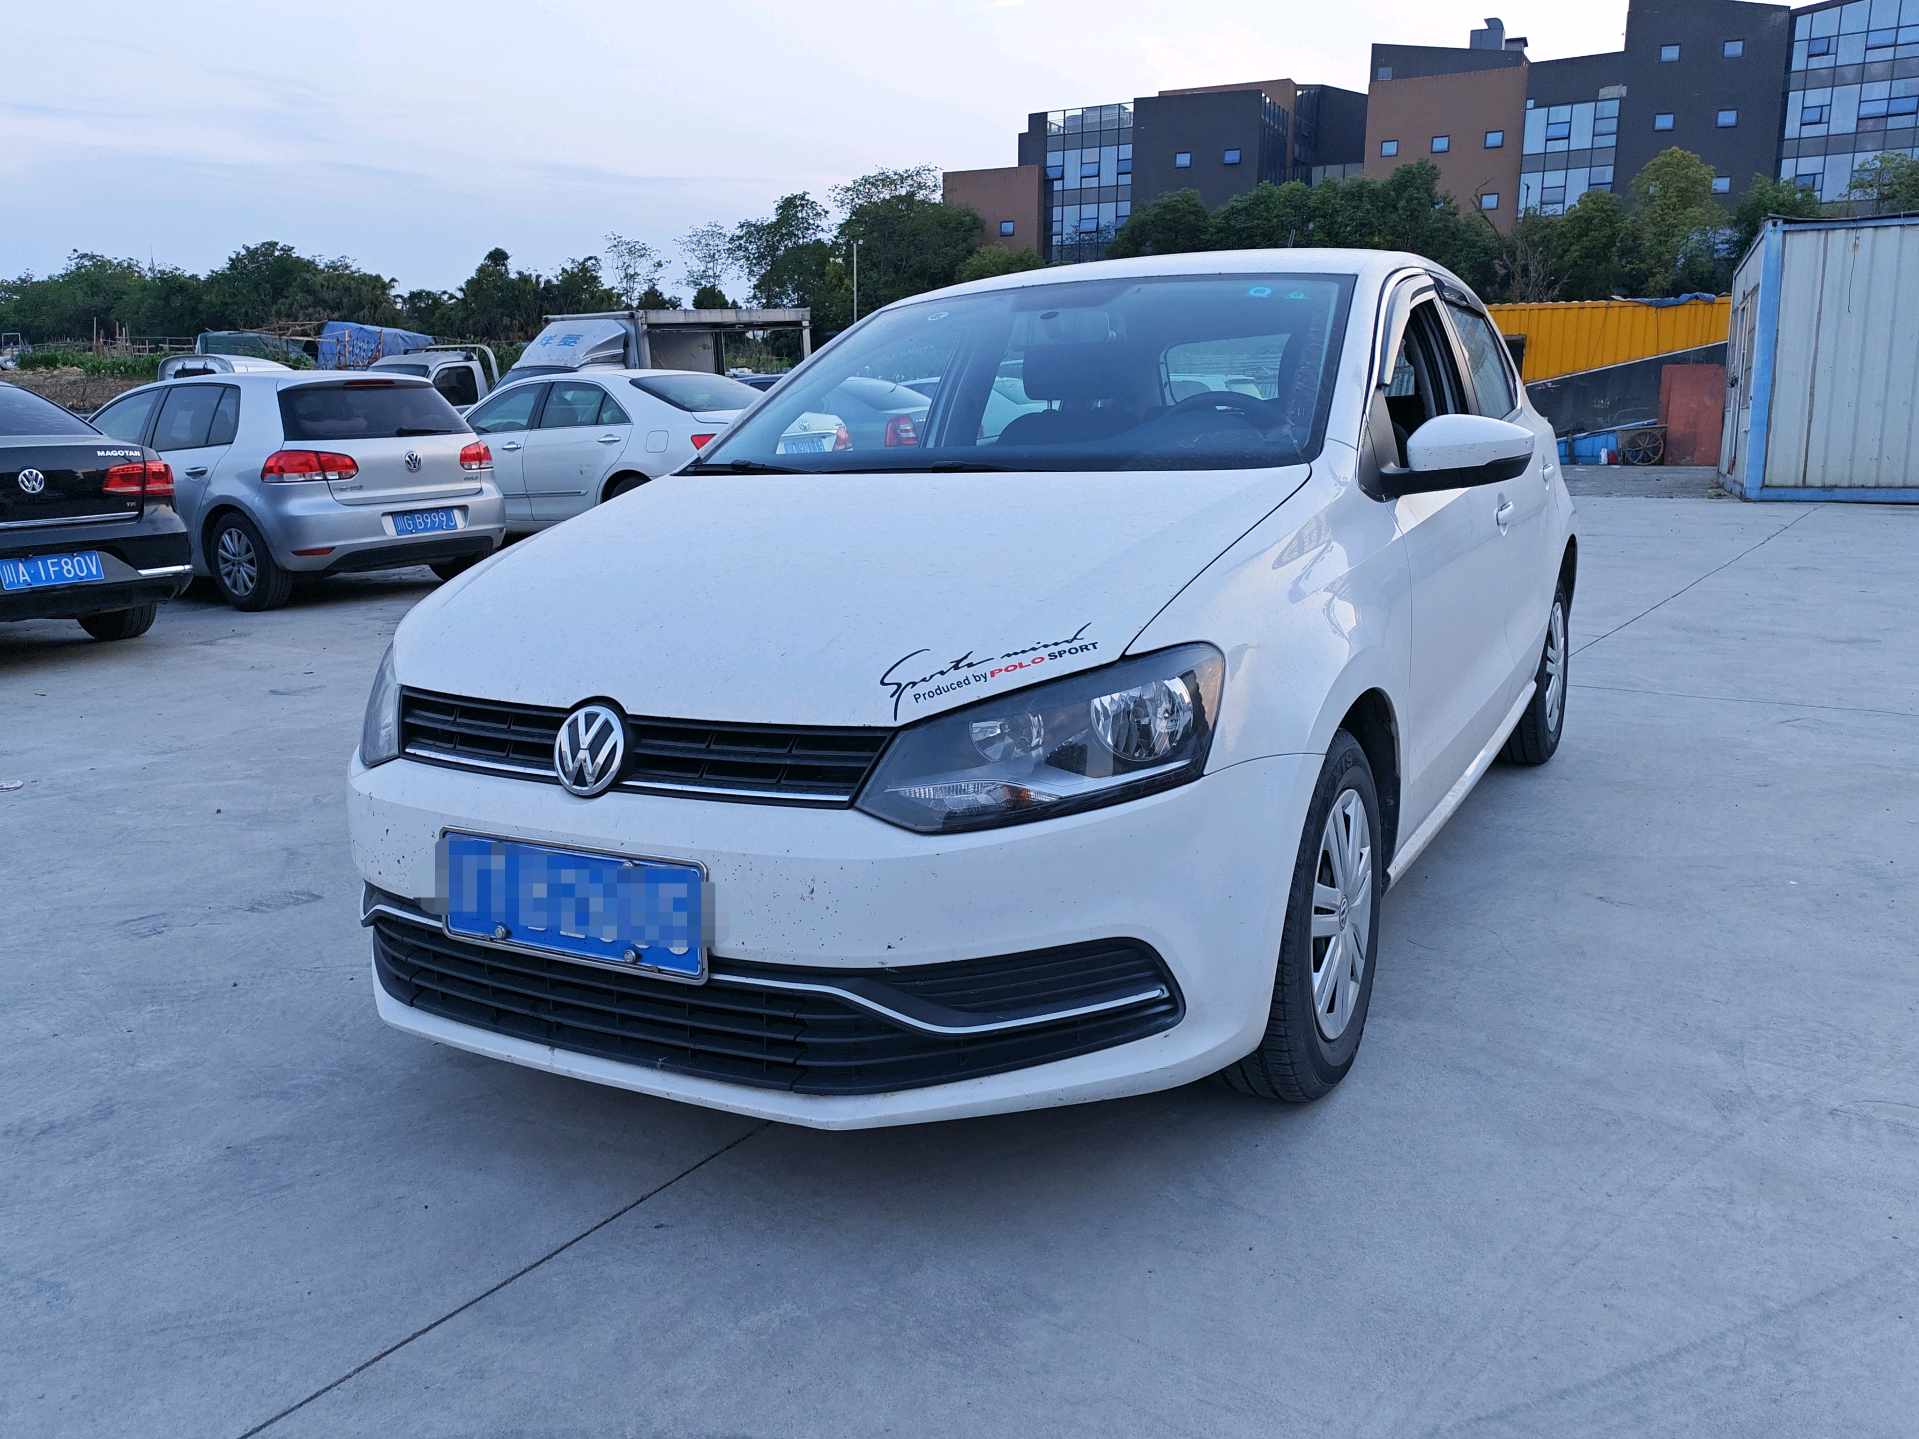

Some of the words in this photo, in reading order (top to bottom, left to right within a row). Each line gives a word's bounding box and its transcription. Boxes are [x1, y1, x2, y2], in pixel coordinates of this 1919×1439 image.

[913, 675, 971, 704] Produced
[975, 672, 989, 684] by
[989, 656, 1045, 679] POLO
[1048, 641, 1099, 661] SPORT
